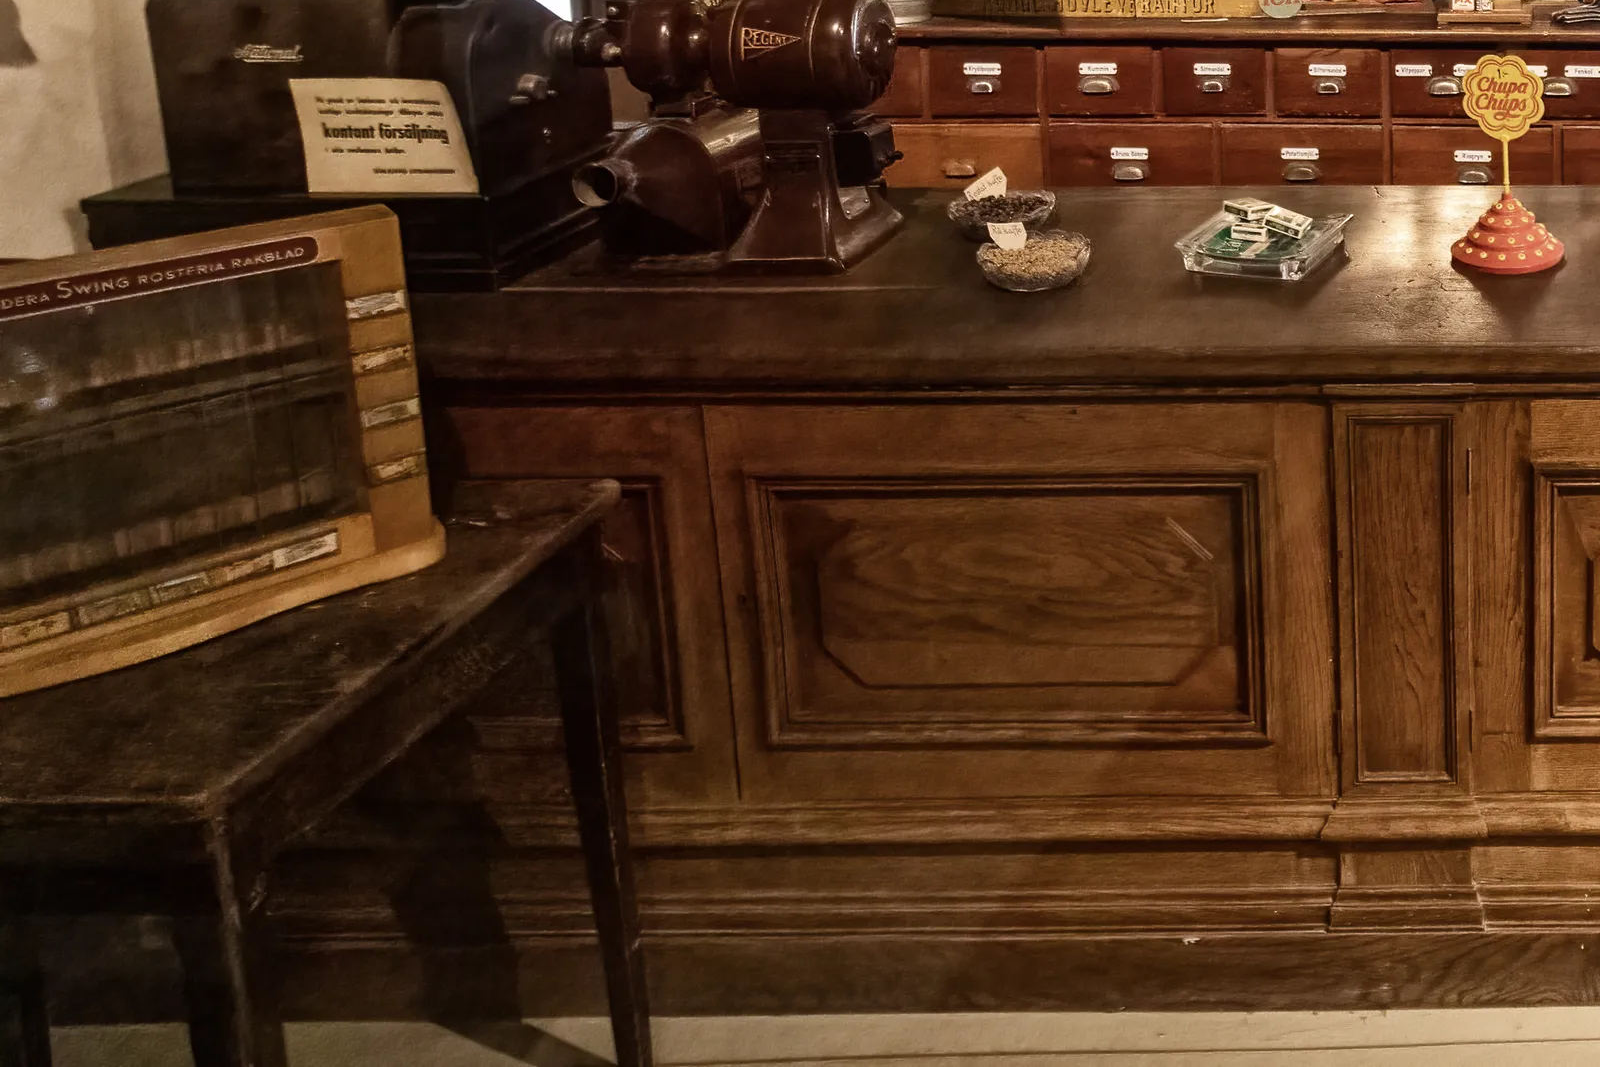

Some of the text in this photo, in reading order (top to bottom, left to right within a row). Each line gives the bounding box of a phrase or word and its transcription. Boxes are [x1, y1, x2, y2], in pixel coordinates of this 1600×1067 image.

[741, 28, 786, 48] REGENT
[1478, 76, 1529, 97] Chupa
[1475, 93, 1528, 118] Chups
[321, 122, 450, 145] kontant försäljning
[0, 292, 50, 311] DERA
[56, 277, 130, 300] SWING
[231, 246, 306, 270] RAKBLAD
